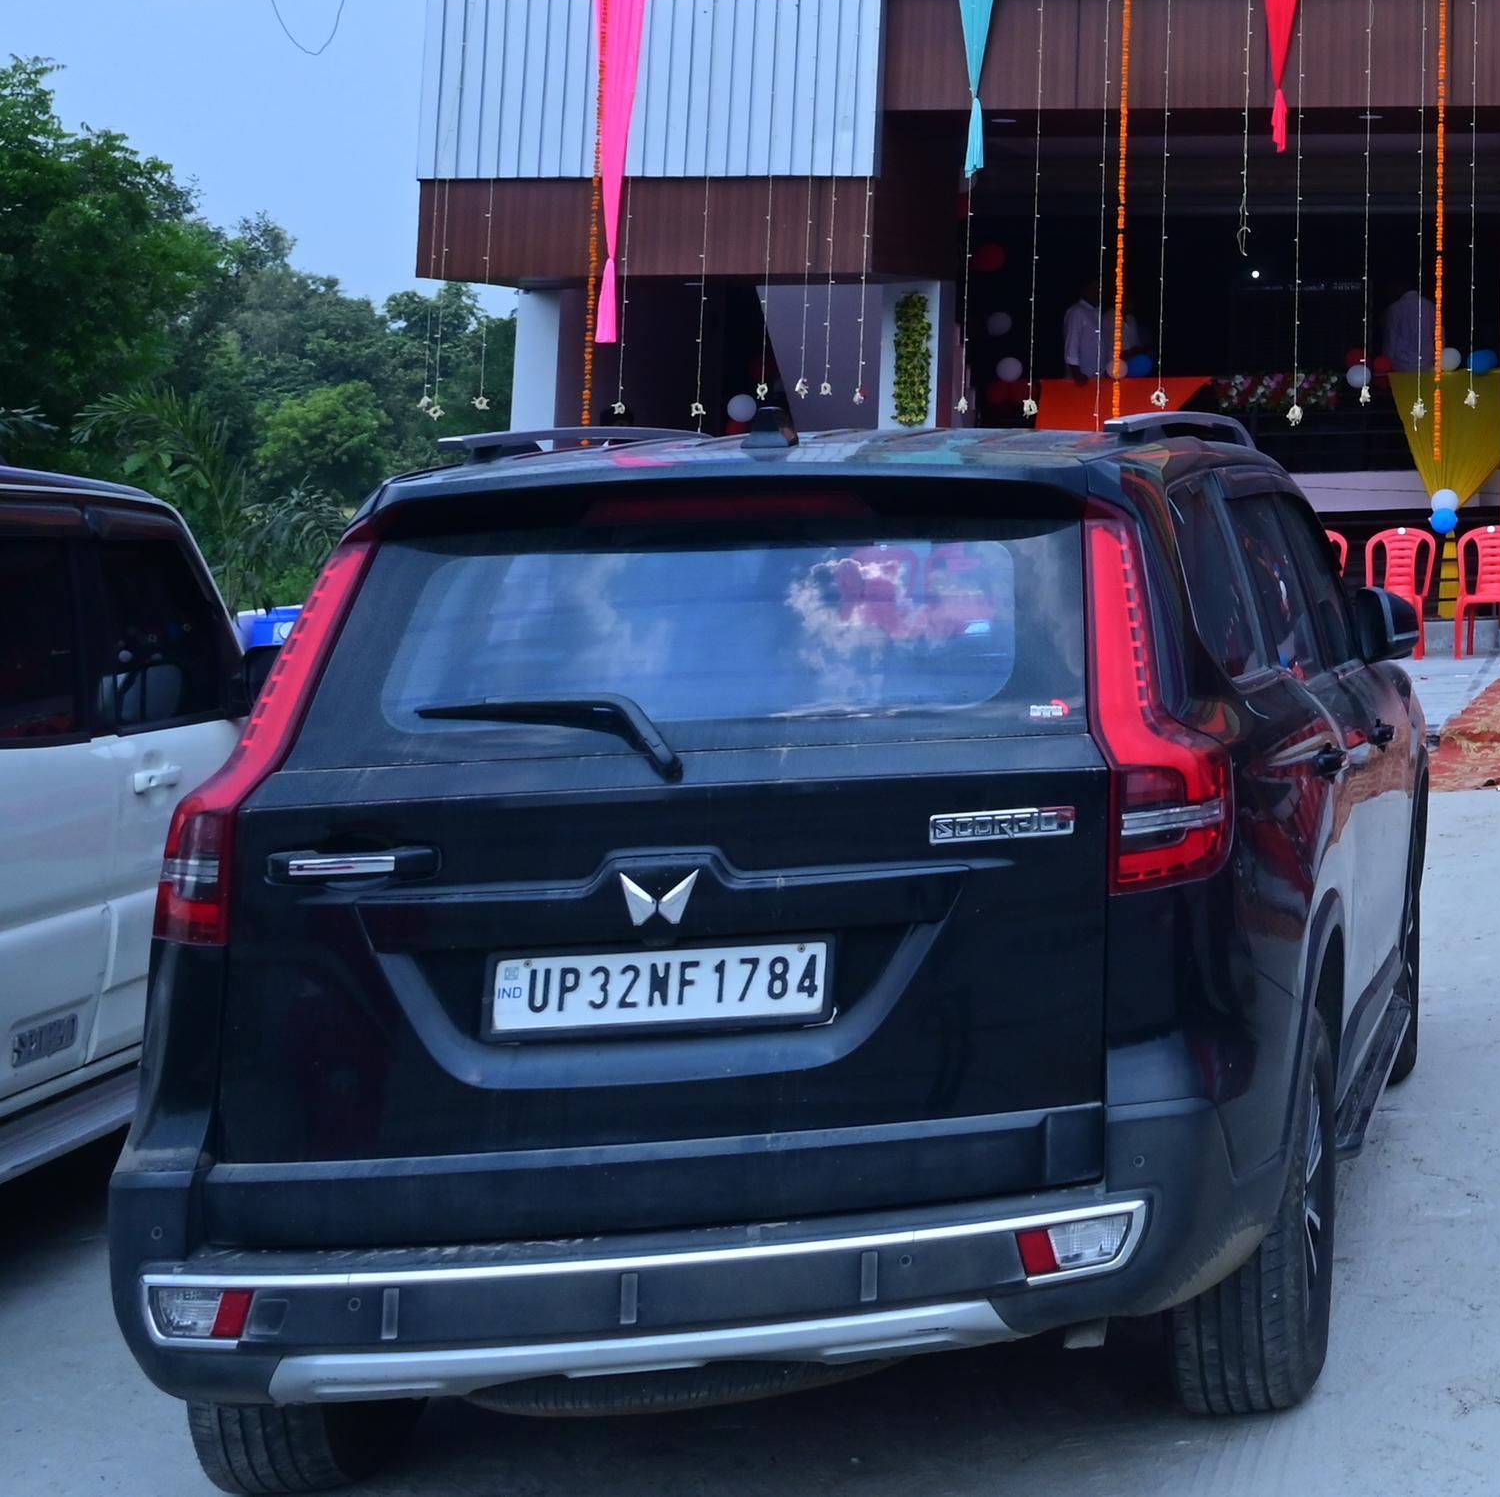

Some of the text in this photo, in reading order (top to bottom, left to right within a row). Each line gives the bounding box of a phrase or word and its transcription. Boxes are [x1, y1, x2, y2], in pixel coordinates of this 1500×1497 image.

[935, 812, 1058, 839] SCORPIO
[497, 954, 818, 1013] IND UP32NF1784
